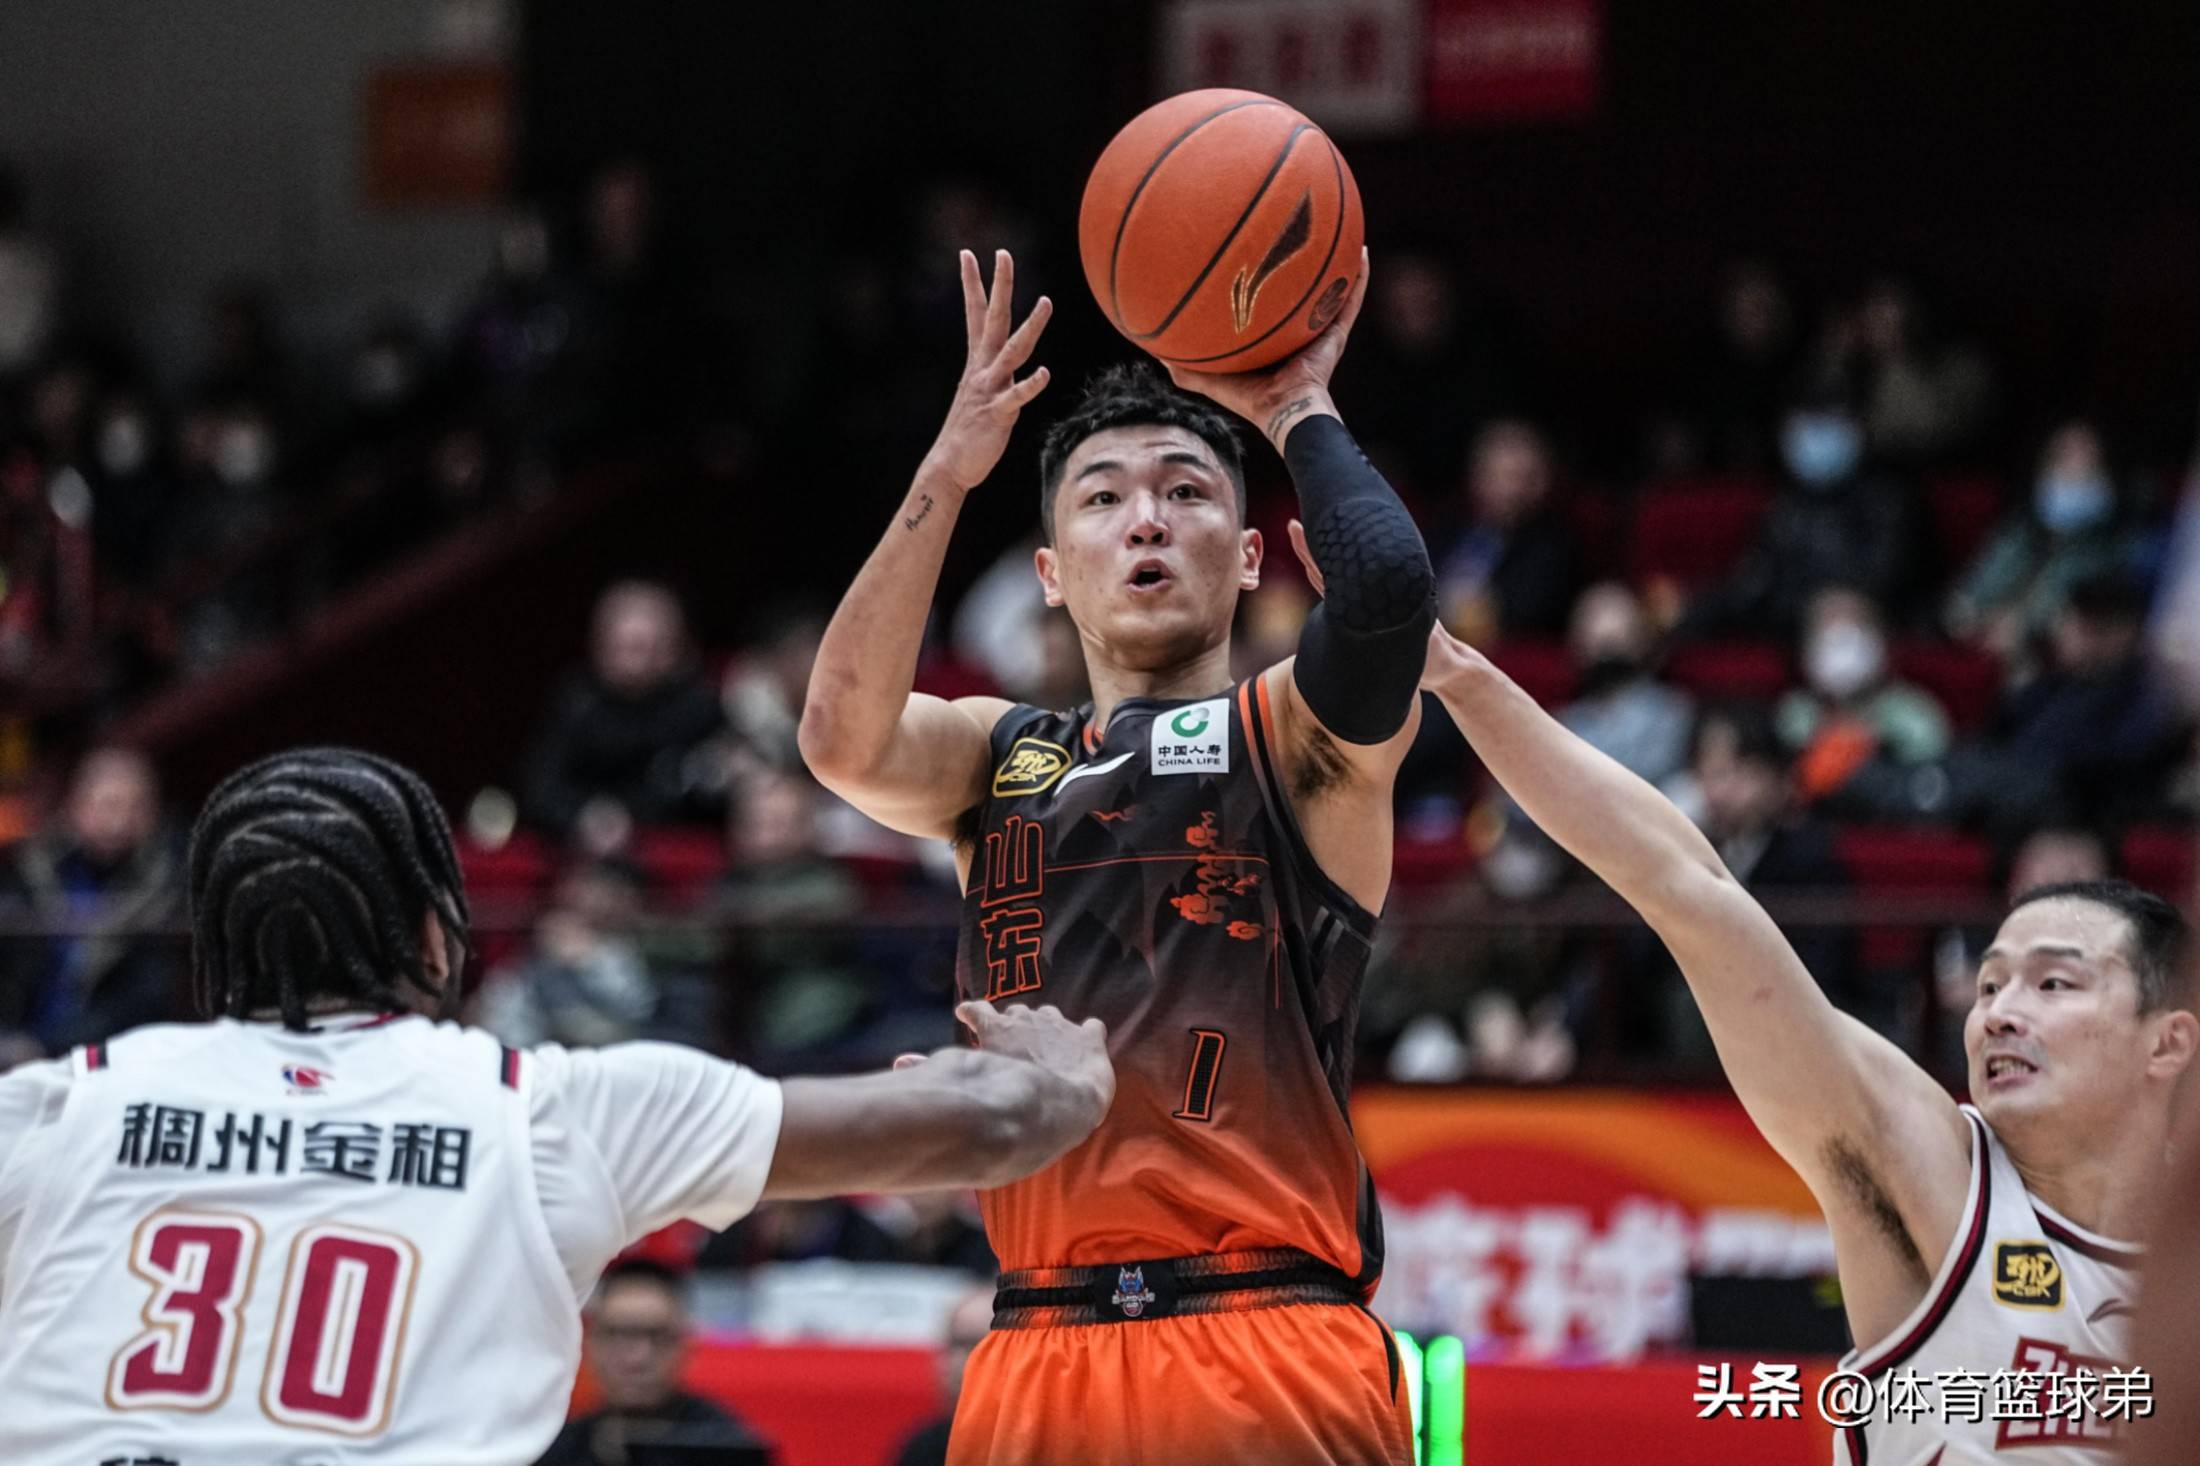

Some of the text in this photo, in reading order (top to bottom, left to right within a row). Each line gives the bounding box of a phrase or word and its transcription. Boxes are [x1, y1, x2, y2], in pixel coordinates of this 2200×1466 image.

[1158, 744, 1221, 757] 中国人寿
[1158, 757, 1221, 766] CHINA LIFE
[980, 815, 1043, 1001] 山东
[1173, 1028, 1227, 1122] 1
[117, 1102, 472, 1191] 稠州金租
[106, 1208, 421, 1440] 30
